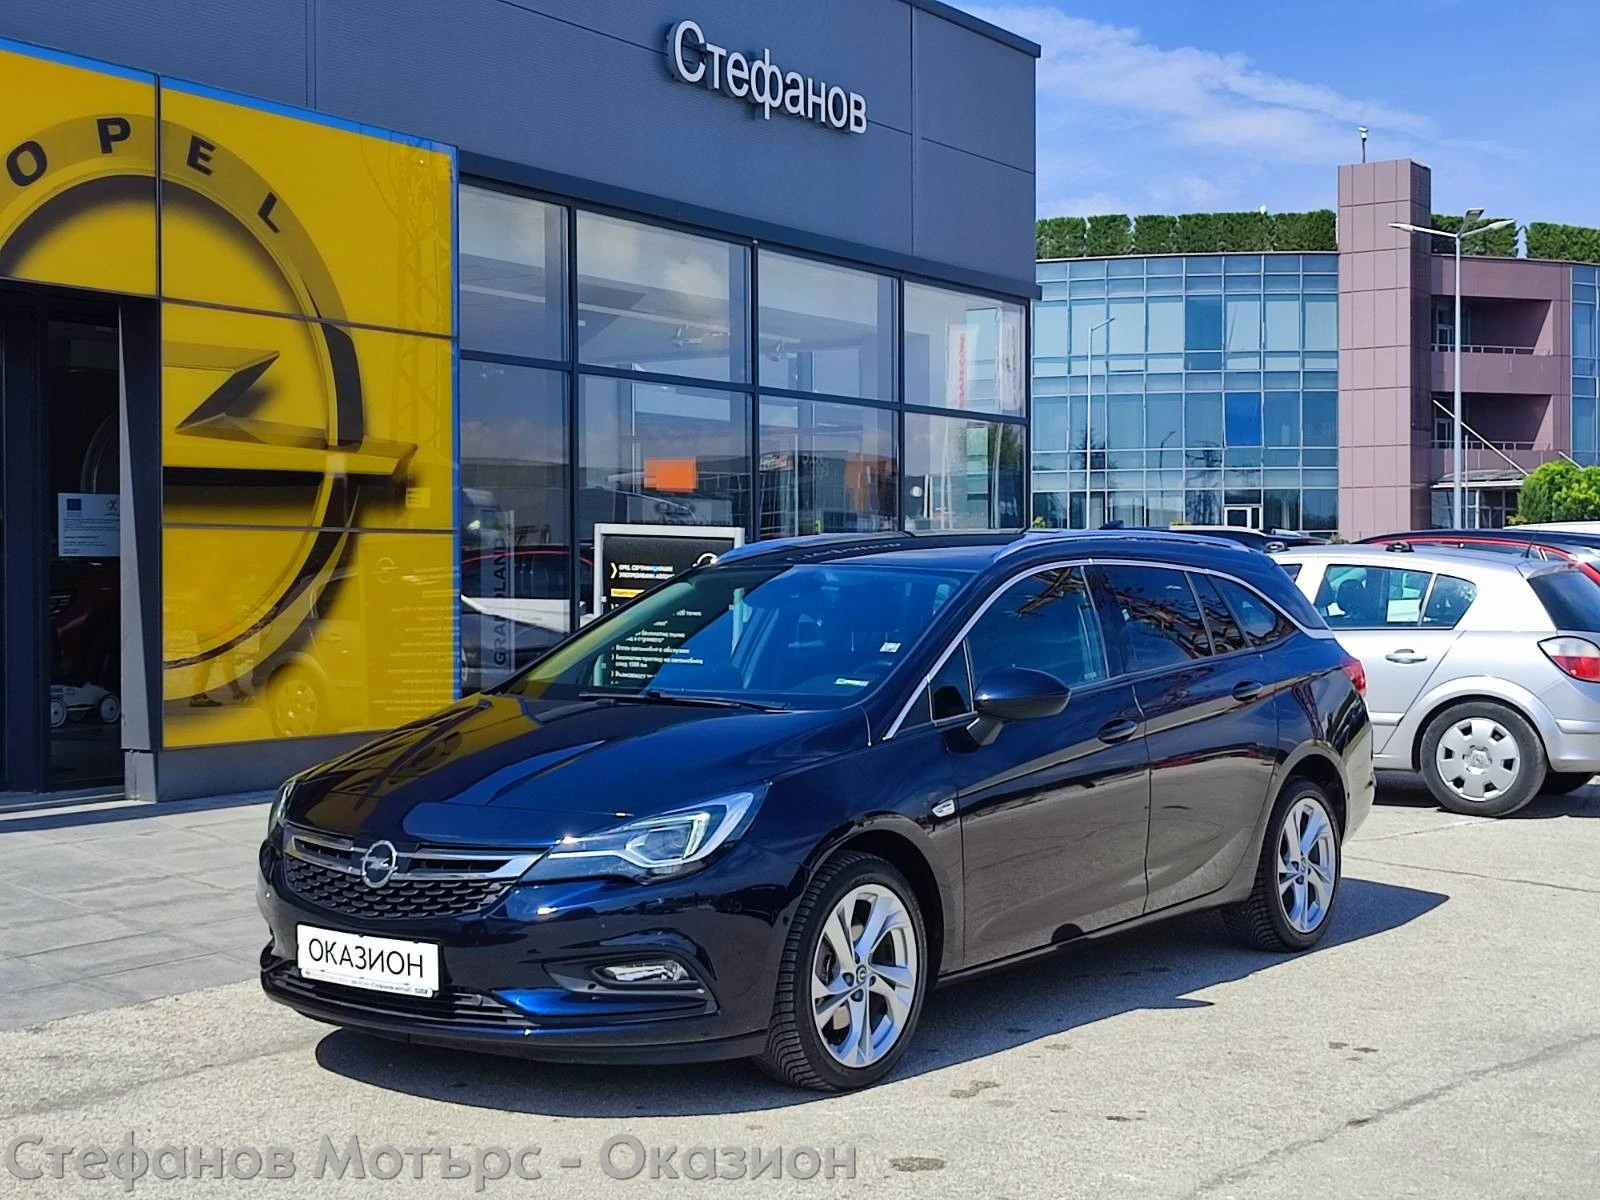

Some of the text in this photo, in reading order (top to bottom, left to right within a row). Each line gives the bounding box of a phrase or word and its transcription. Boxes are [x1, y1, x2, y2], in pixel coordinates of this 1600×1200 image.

[668, 20, 867, 134] Стефанов
[6, 117, 281, 234] OPEL
[493, 538, 507, 665] GRALAND
[309, 938, 423, 978] ОКАЗИОН
